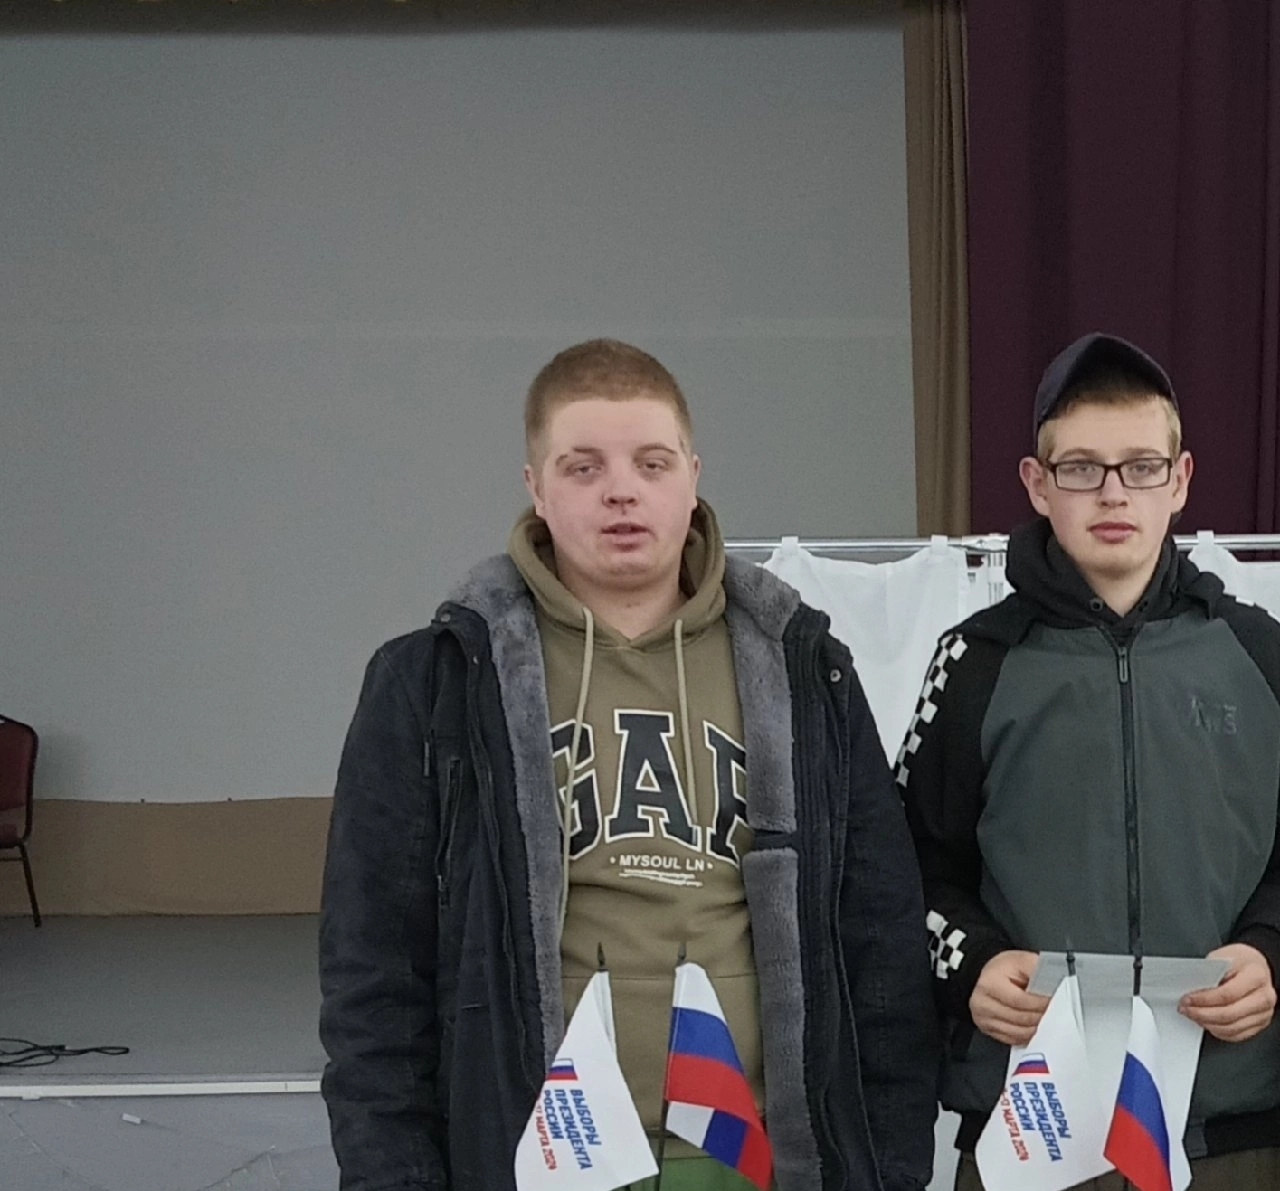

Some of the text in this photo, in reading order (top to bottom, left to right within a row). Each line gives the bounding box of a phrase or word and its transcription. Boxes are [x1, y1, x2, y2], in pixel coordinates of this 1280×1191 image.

[619, 855, 705, 871] MYSOUL LN
[544, 1090, 564, 1139] РОССИИ
[554, 1089, 593, 1170] ПРЕЗИДЕНТА
[570, 1089, 602, 1145] ВЫБОРЫ
[1010, 1082, 1035, 1130] РОССИИ
[1024, 1082, 1063, 1162] ПРЕЗИДЕНТА
[1041, 1082, 1072, 1139] ВЫБОРЫ
